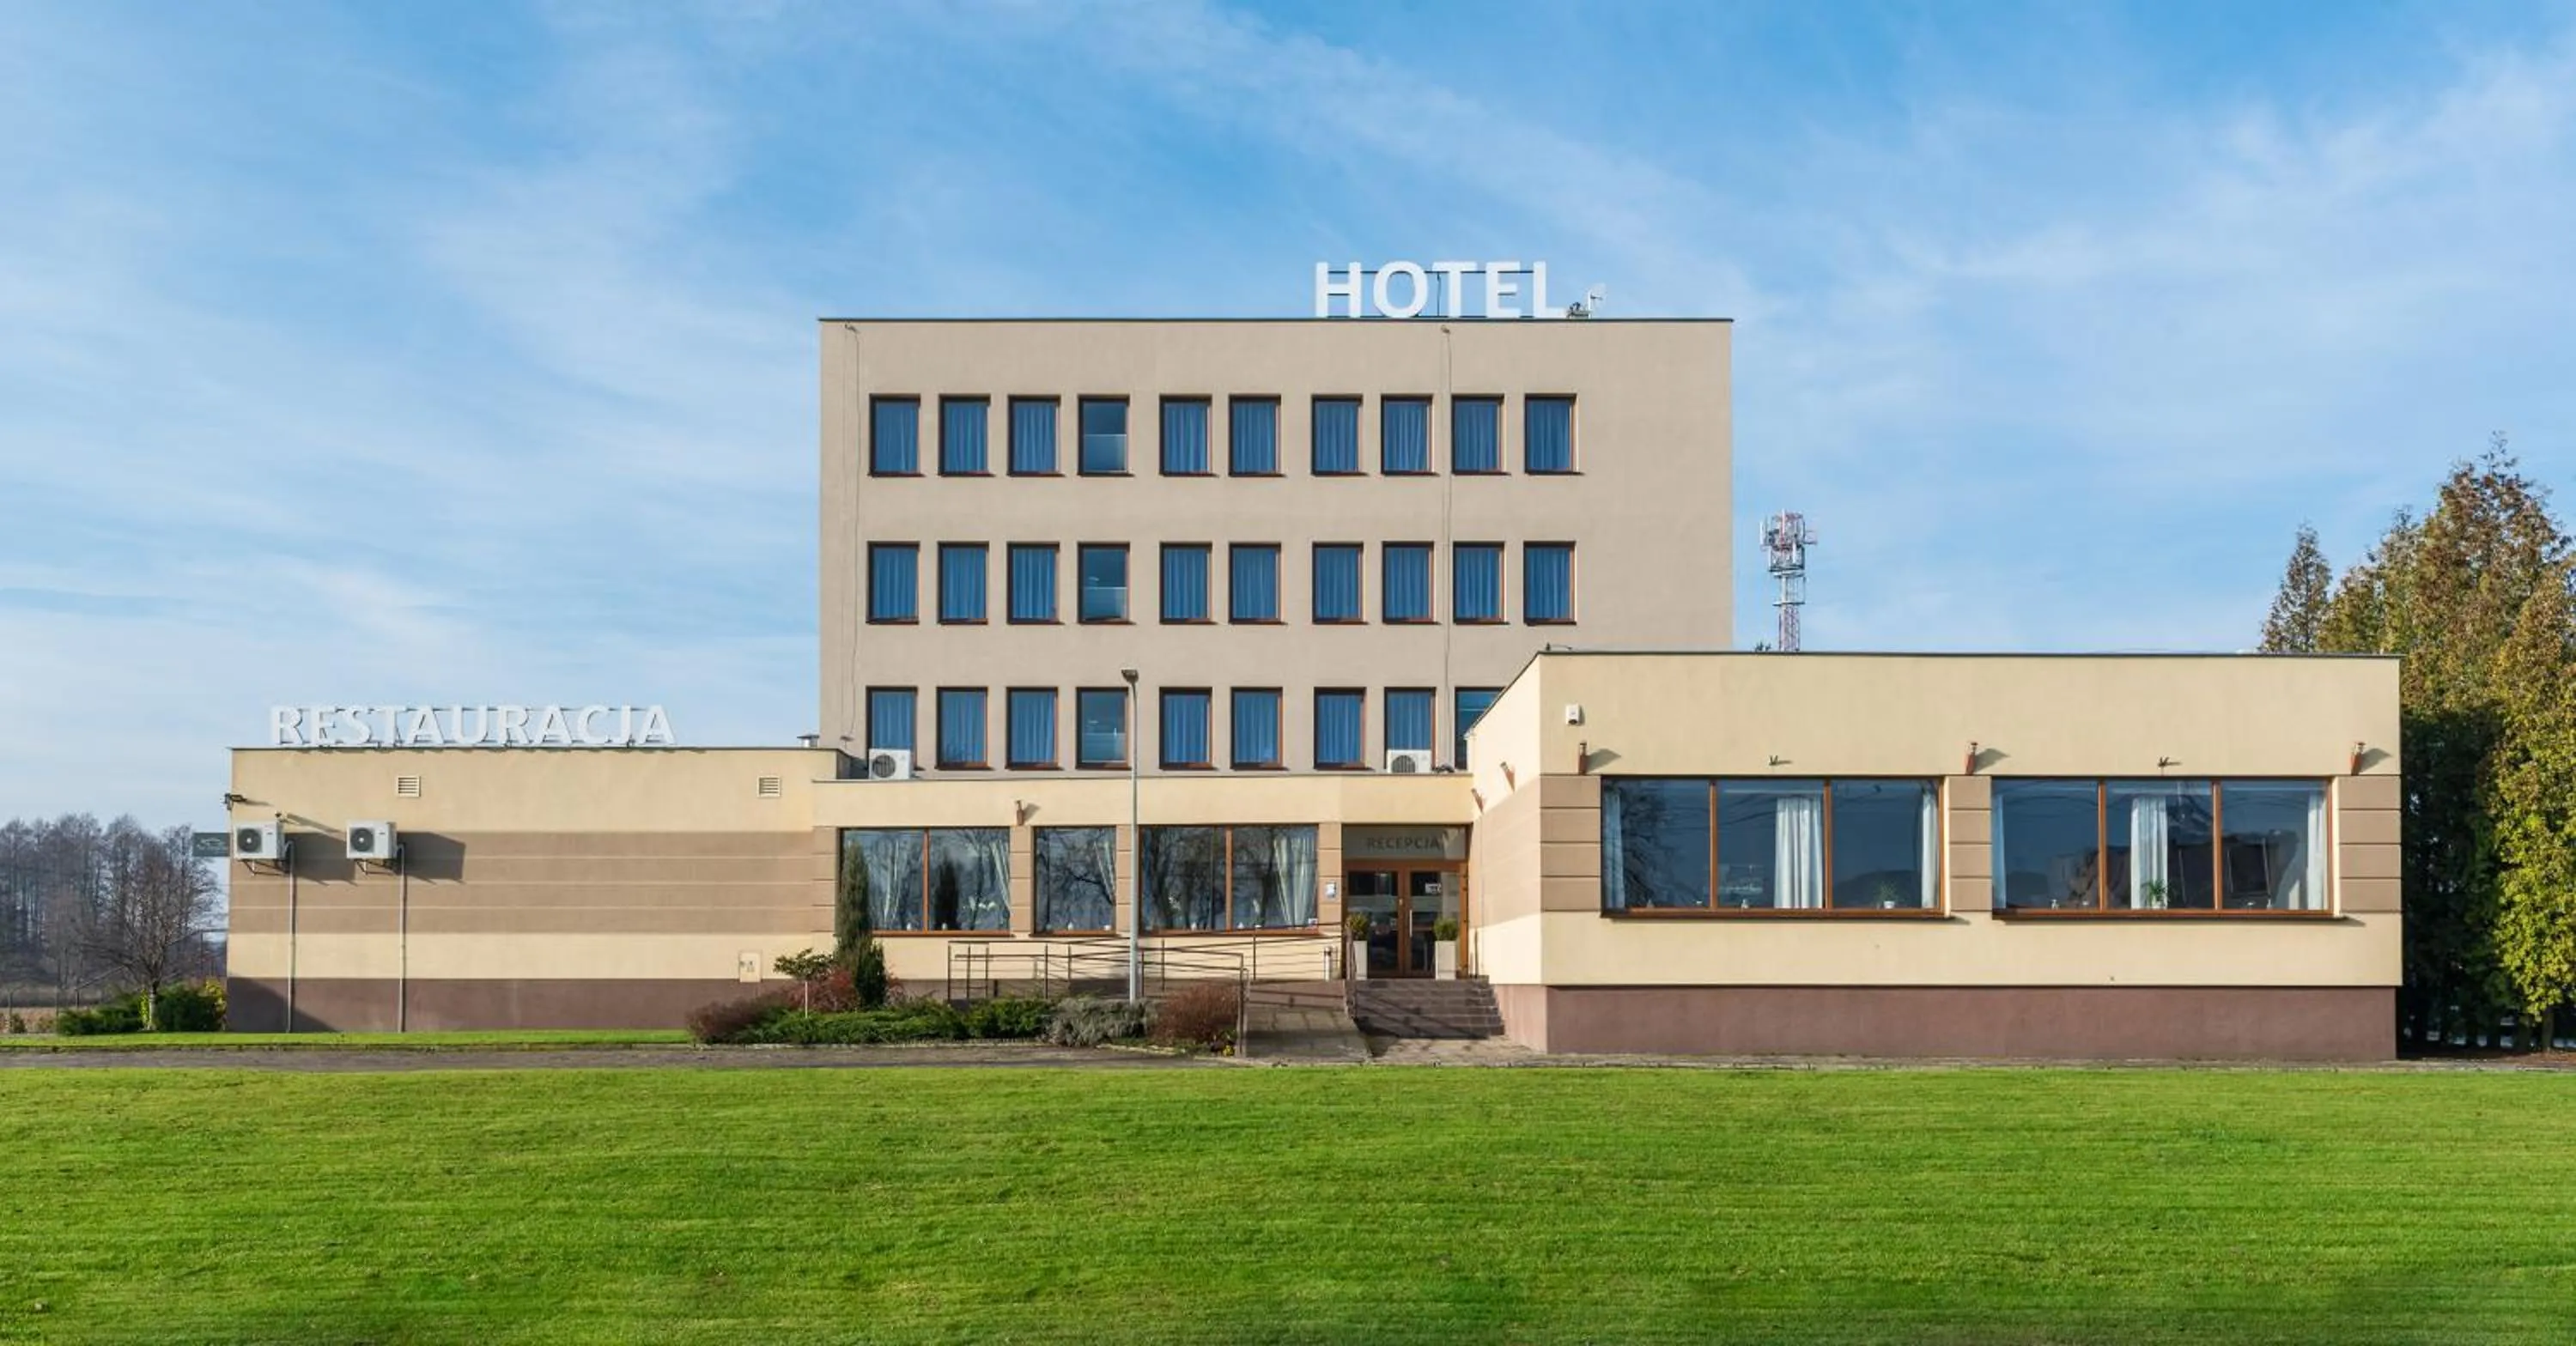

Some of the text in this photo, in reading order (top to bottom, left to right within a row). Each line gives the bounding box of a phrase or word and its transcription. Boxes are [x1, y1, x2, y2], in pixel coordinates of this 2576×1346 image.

[1315, 260, 1567, 318] HOTEL
[270, 704, 676, 746] RESTAURACJA
[1366, 836, 1441, 850] RECEPCJA
